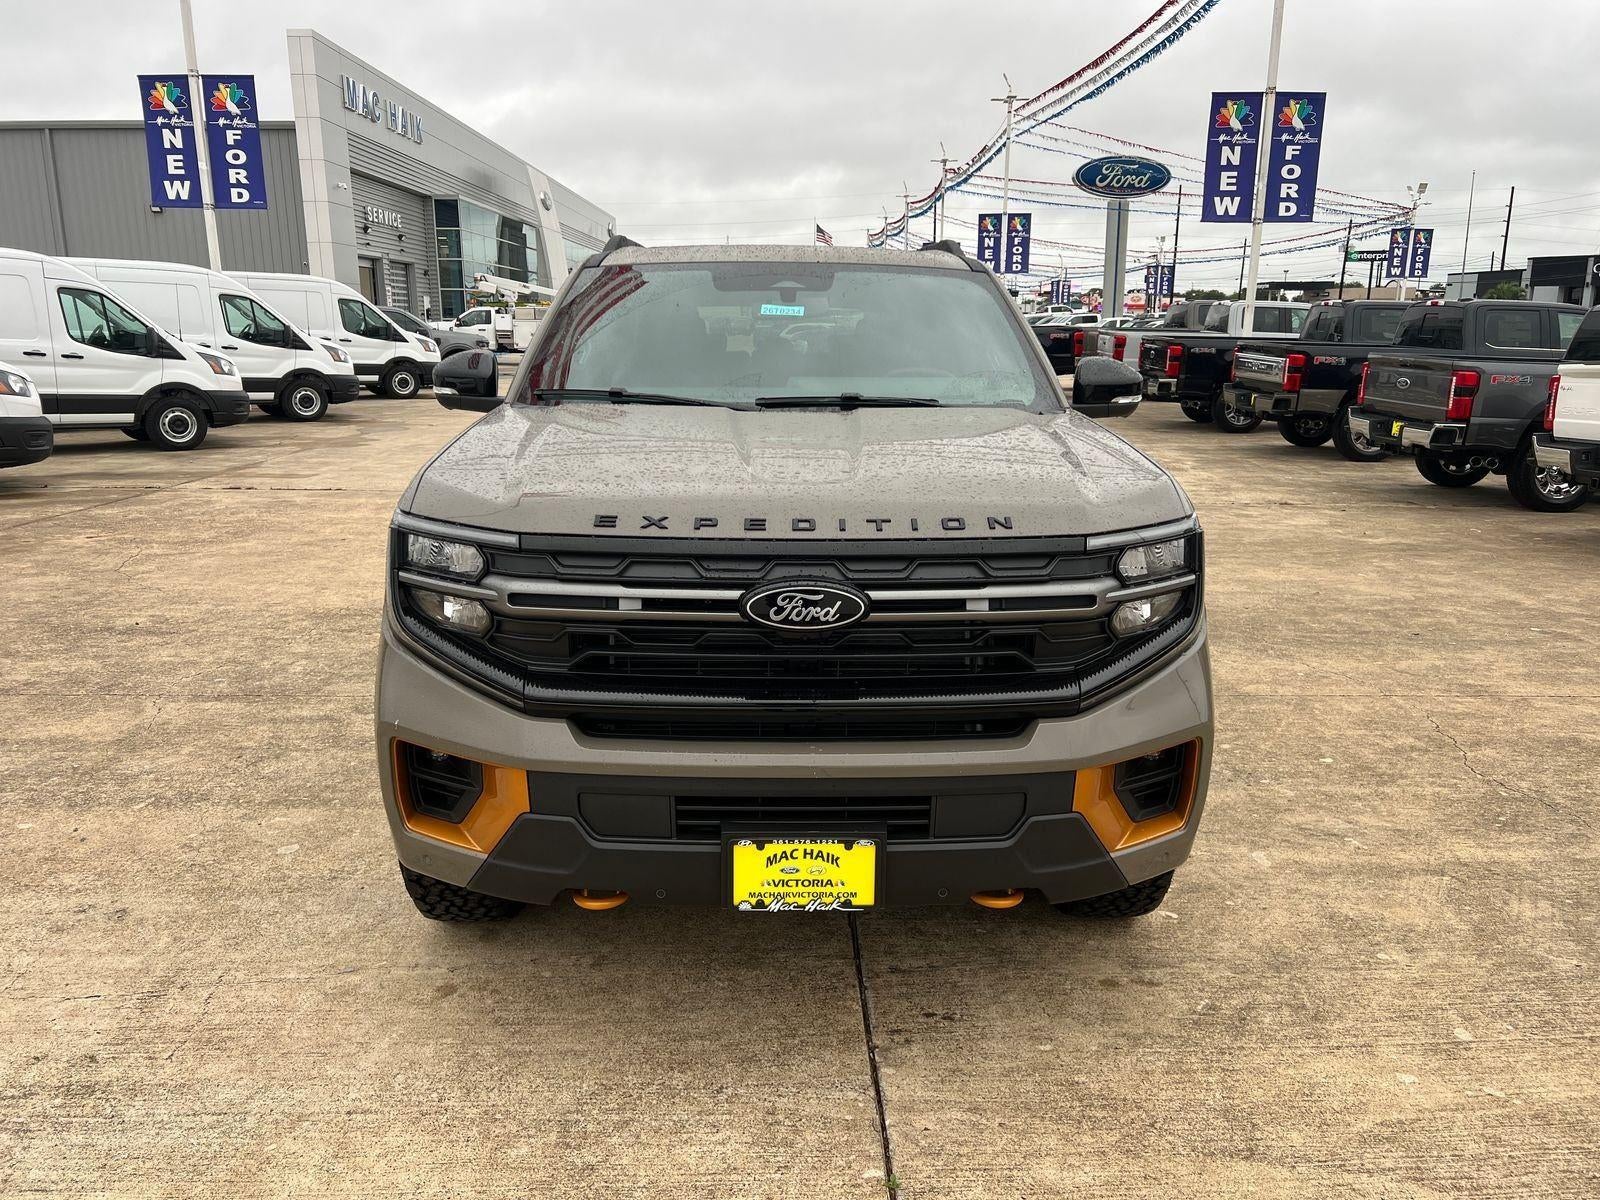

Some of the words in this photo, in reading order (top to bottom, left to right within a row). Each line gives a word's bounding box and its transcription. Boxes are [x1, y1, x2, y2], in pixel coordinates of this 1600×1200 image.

[341, 74, 381, 123] MAC
[385, 98, 423, 145] HAIK
[162, 128, 191, 200] NEW
[225, 130, 250, 203] FORD
[1095, 163, 1151, 188] Ford
[1213, 145, 1241, 216] NEW
[1278, 145, 1302, 217] FORD
[367, 206, 402, 228] SERVICE
[1012, 237, 1023, 271] FORD
[1351, 252, 1388, 260] enterpri
[1390, 248, 1403, 275] NEW
[1414, 249, 1424, 276] FORD
[1490, 375, 1534, 385] FX4
[593, 514, 1013, 533] EXPEDITION
[769, 592, 842, 622] Ford
[765, 848, 799, 868] MAC
[803, 848, 840, 868] HAIK
[748, 891, 857, 899] MACHAIKVICTORIA.COM
[772, 879, 834, 888] VICTORIA
[767, 897, 803, 912] Mac
[804, 897, 844, 912] Haik
